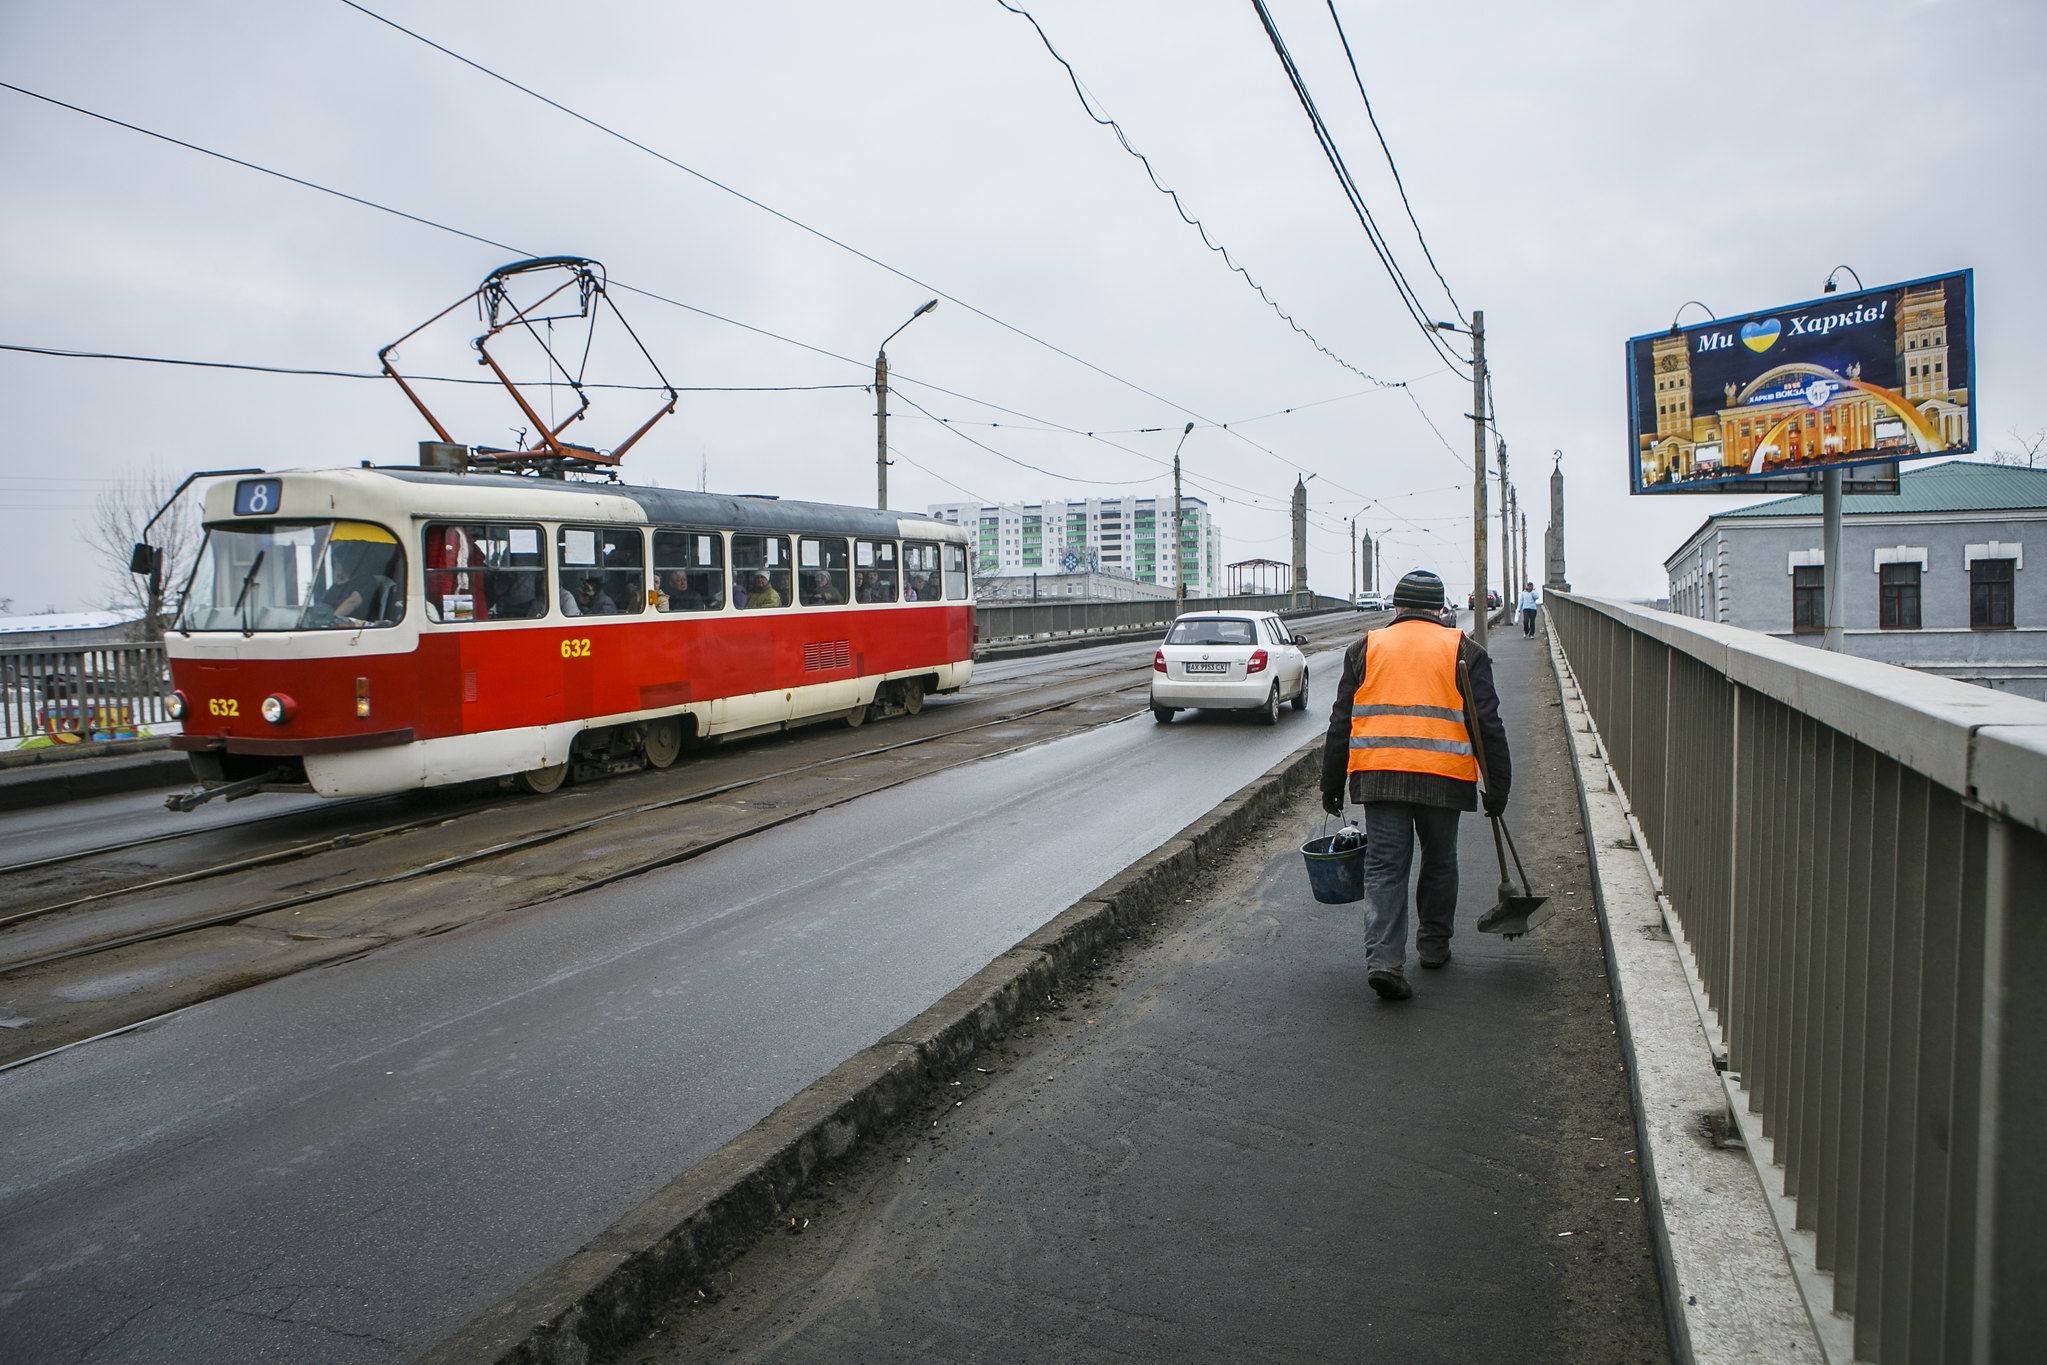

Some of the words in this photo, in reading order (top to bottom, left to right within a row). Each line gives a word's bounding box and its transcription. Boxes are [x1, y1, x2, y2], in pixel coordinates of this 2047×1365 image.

[1697, 332, 1734, 353] Ми
[1787, 300, 1888, 337] Харків!
[1775, 387, 1807, 399] ВОКЗА
[249, 484, 268, 512] 8
[561, 638, 591, 658] 632
[209, 698, 240, 717] 632
